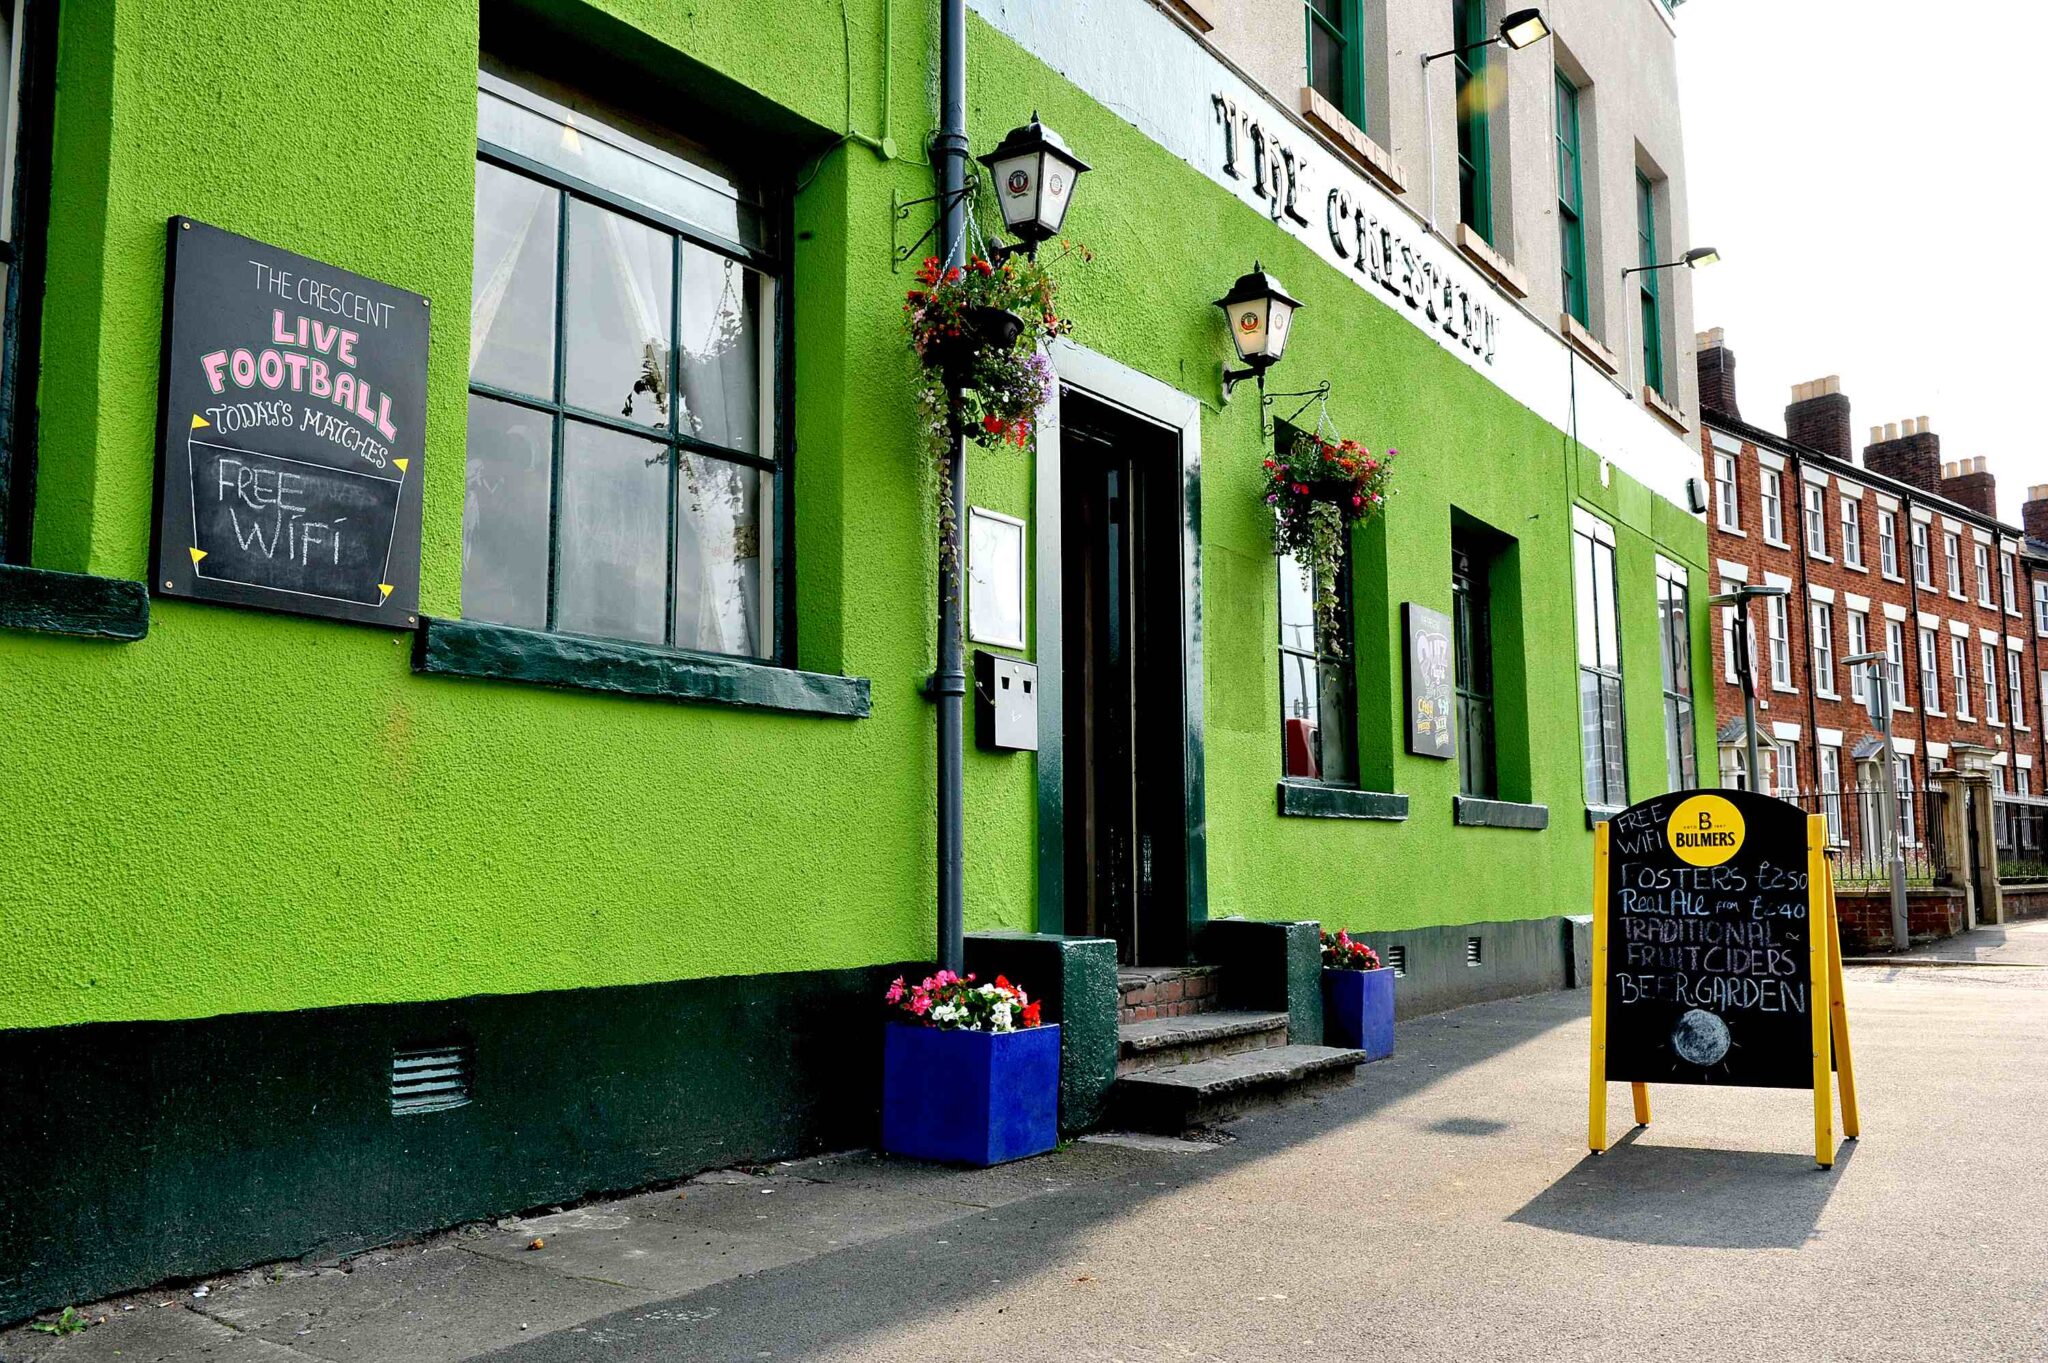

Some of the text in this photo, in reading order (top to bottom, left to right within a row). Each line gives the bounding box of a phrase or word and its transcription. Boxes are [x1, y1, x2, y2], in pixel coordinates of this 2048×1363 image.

[1211, 92, 1500, 366] THE CRESCENT
[249, 260, 395, 329] THE CRESCENT
[272, 309, 359, 368] LIVE
[201, 348, 397, 443] FOOTBALL
[206, 400, 388, 468] TODAY'S MATCHES
[219, 459, 306, 509] FREE
[1617, 803, 1667, 833] FREE
[1699, 812, 1712, 830] B
[1617, 829, 1663, 854] WIFI
[1676, 832, 1735, 847] BULMERS
[1622, 862, 1747, 891] FOSTERS
[1619, 916, 1781, 947] TRADITIONAL
[1627, 942, 1796, 976] FRUIT CIDERS
[1695, 975, 1805, 1013] GARDEN
